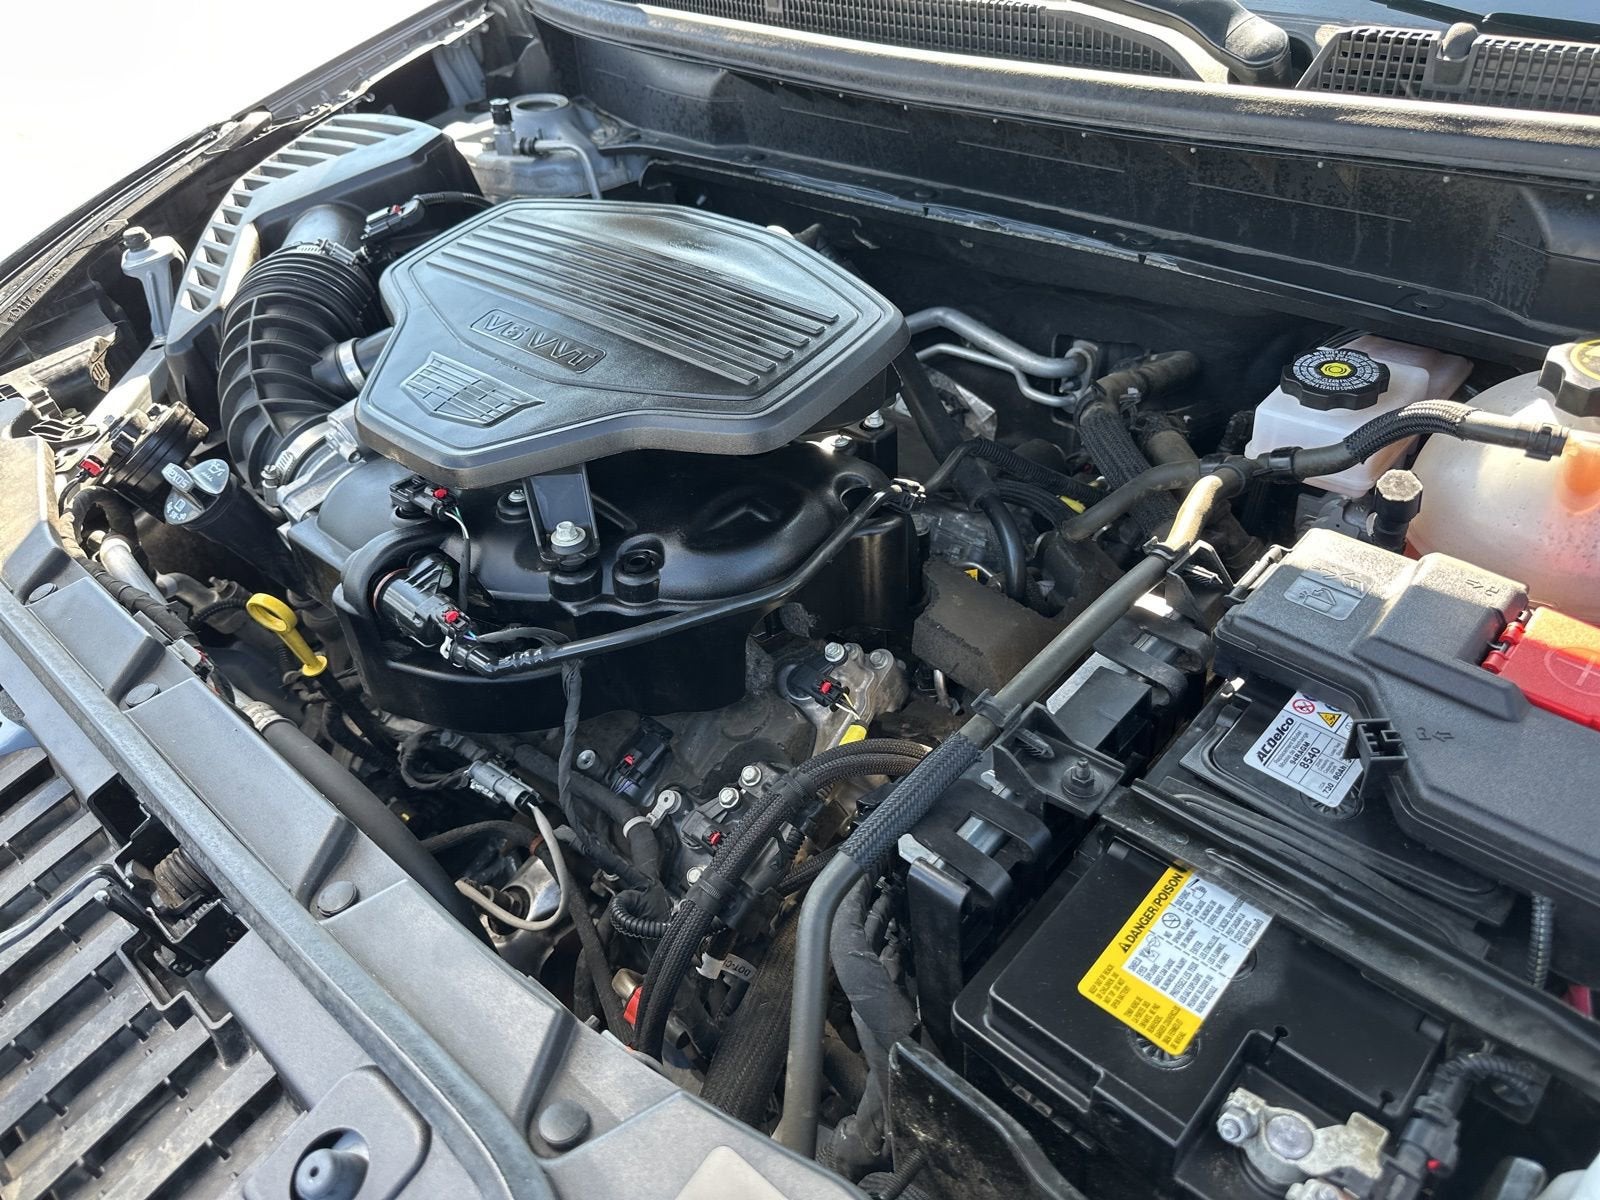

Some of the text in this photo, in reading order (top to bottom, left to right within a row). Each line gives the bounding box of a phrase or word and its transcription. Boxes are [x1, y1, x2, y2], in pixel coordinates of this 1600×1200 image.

[485, 314, 599, 367] V6 VVT
[1256, 717, 1294, 763] ACDelco
[1299, 747, 1321, 769] 8540
[1322, 782, 1334, 794] 730
[1125, 872, 1184, 943] DANGER/POISON
